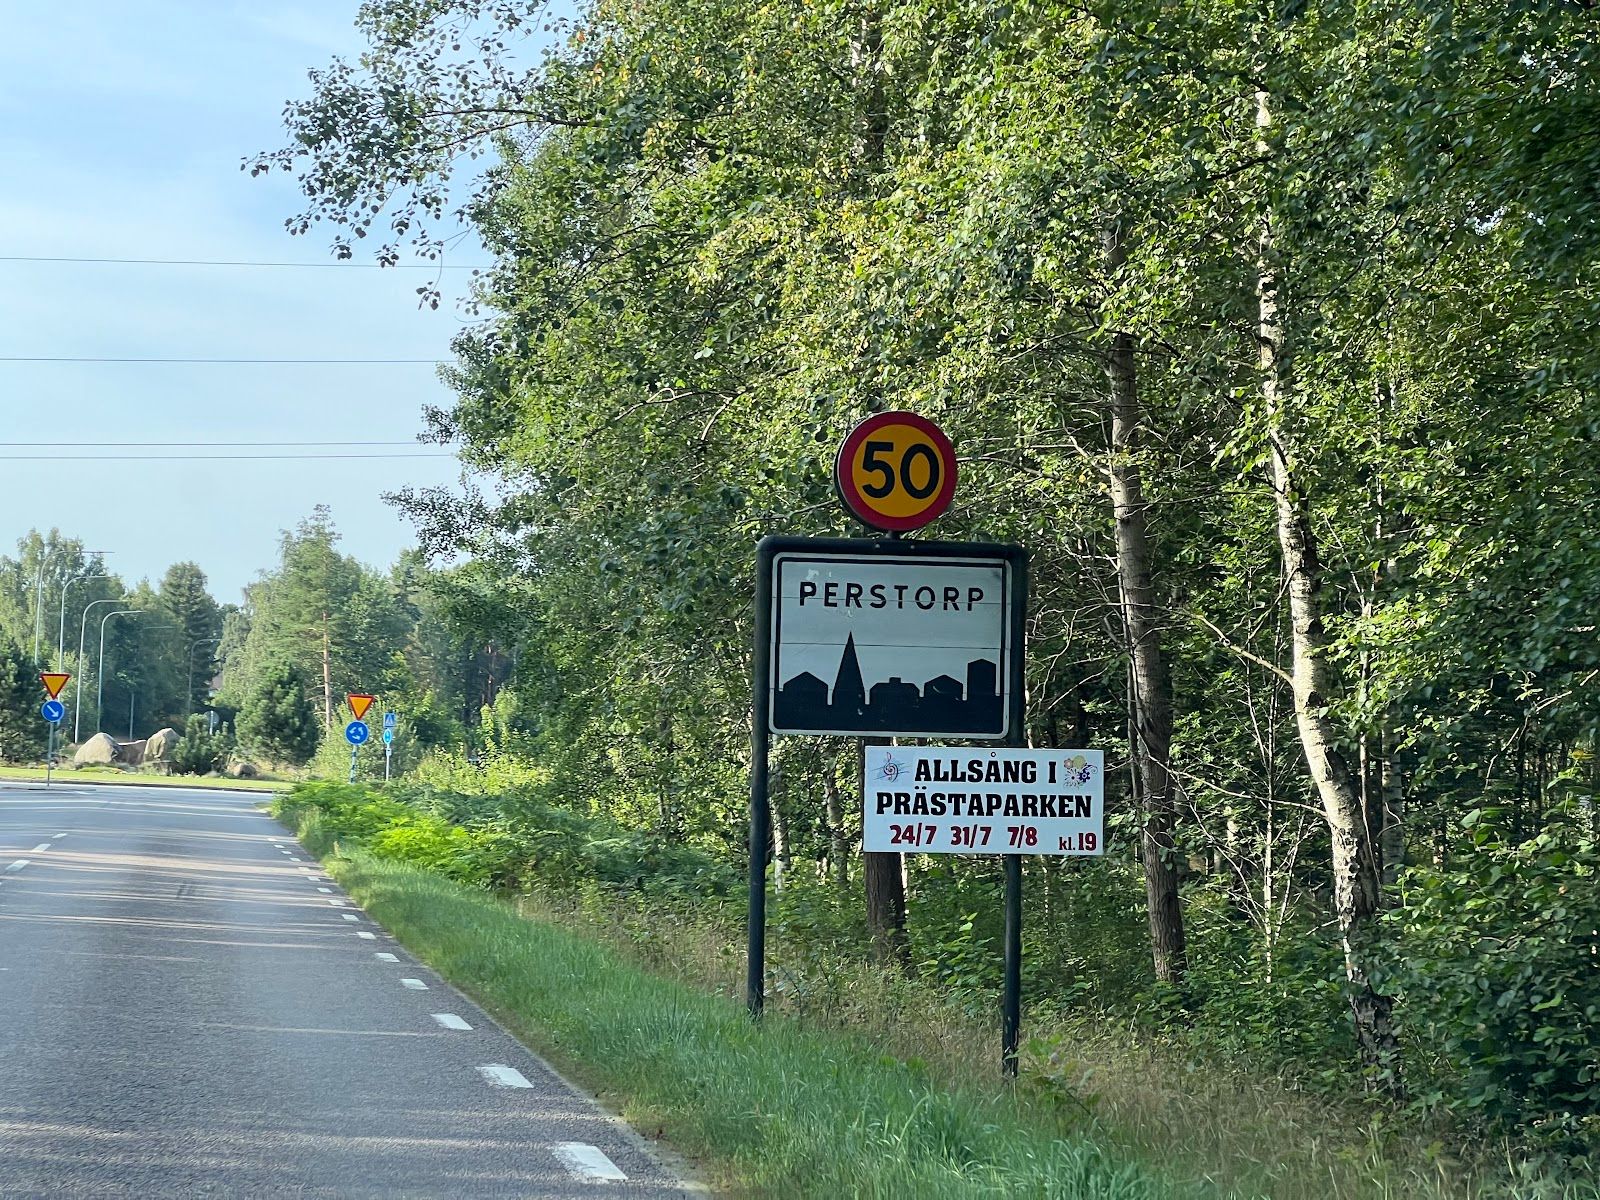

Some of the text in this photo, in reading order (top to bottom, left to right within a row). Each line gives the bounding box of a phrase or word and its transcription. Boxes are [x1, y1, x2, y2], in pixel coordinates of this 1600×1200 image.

[861, 440, 940, 500] 50
[800, 581, 984, 612] PERSTORP
[914, 752, 1057, 784] ALLSÅNG I
[876, 785, 1092, 818] PRÄSTAPARKEN
[889, 822, 937, 847] 24/7
[950, 824, 992, 849] 31/7
[1007, 824, 1038, 849] 7/8
